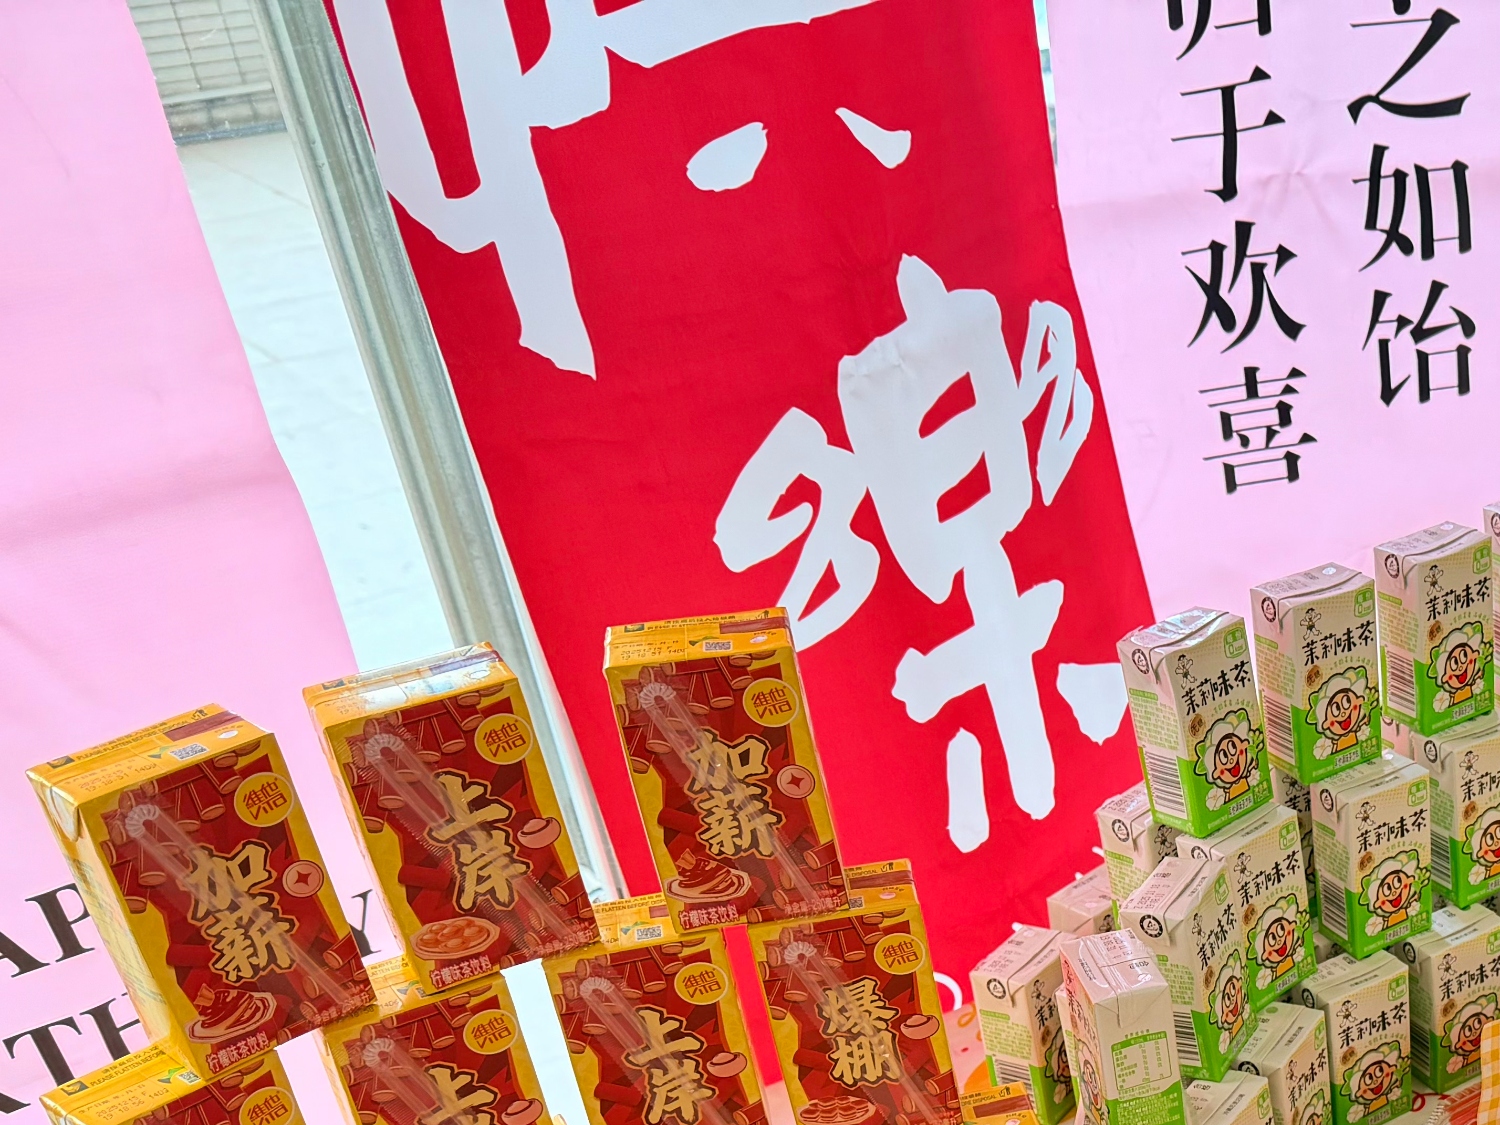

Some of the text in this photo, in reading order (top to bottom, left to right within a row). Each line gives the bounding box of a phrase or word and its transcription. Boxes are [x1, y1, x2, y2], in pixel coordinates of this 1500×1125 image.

[1425, 577, 1492, 622] 茉莉味茶
[1302, 620, 1375, 667] 茉莉味茶
[1181, 660, 1250, 716] 茉莉味茶
[1356, 809, 1428, 854] 茉莉味茶
[1237, 850, 1300, 908] 茉莉味茶
[1338, 1002, 1408, 1049] 茉莉味茶
